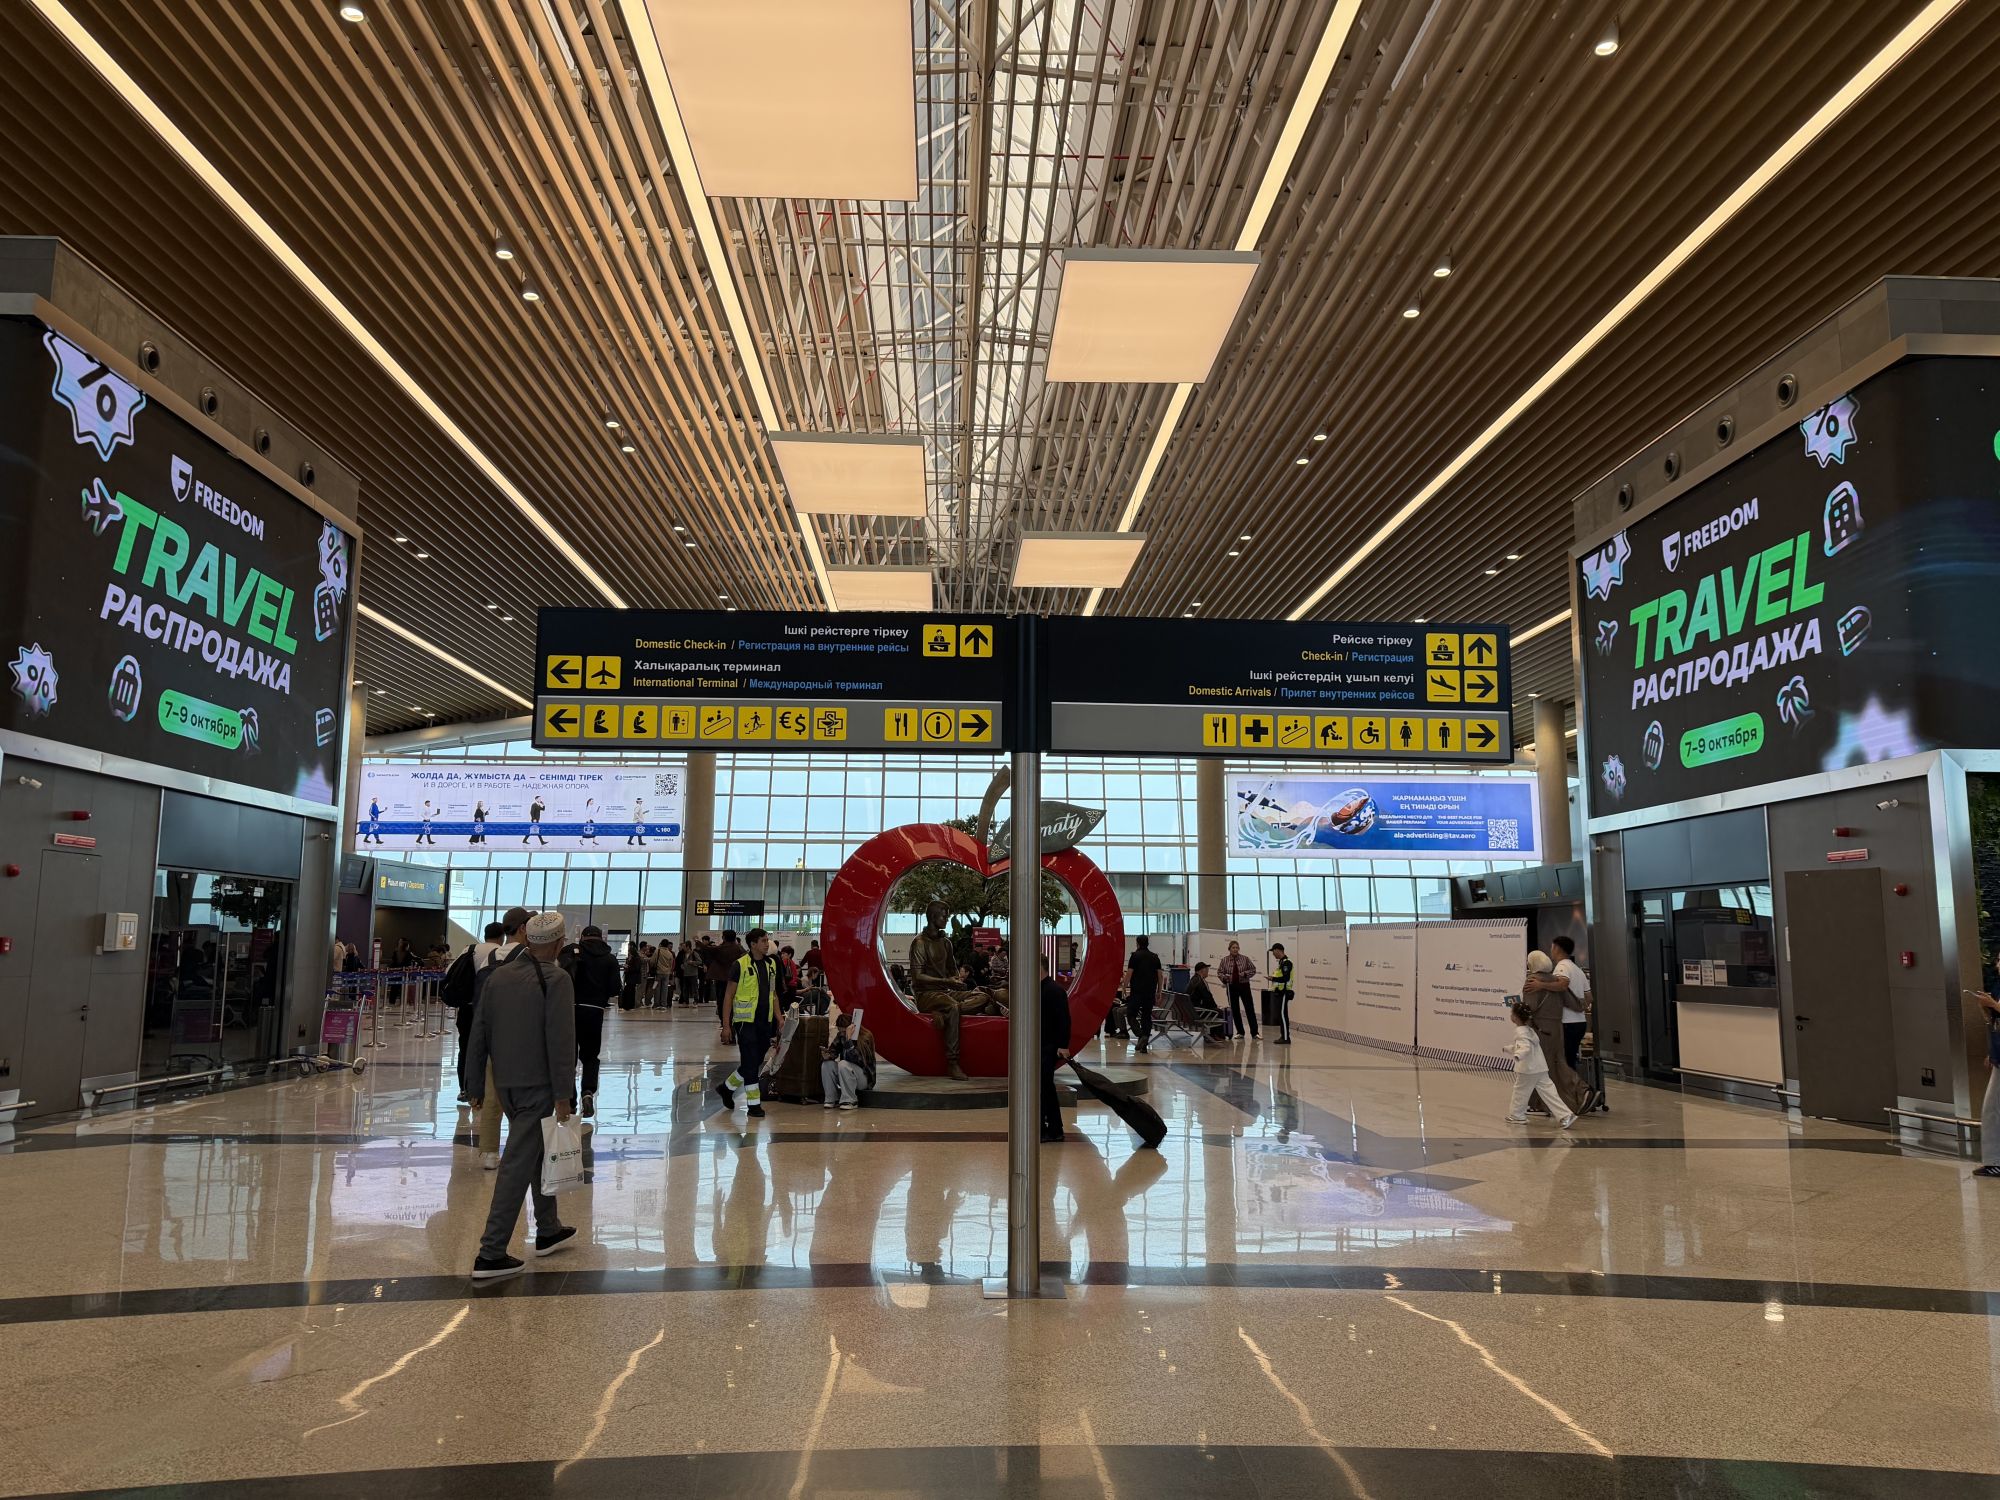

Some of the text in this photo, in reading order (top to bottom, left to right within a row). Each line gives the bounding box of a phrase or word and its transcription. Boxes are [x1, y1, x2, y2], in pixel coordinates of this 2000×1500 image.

[194, 480, 265, 541] FREEDOM
[1684, 497, 1759, 557] FREEDOM
[111, 491, 298, 655] TRAVEL
[1630, 531, 1825, 669] TRAVEL
[100, 583, 292, 695] РАСПРОДАЖА
[784, 625, 909, 639] Ішкі рейстерге тіркеу
[635, 639, 681, 649] Domestic
[684, 639, 727, 650] Check-in
[738, 640, 801, 653] Регистрация
[803, 643, 815, 651] на
[818, 643, 875, 654] внутренние
[877, 643, 909, 654] рейсы
[1333, 634, 1413, 647] Рейске тіркеу
[1301, 651, 1343, 661] Check-in
[1351, 652, 1414, 664] Регистрация
[1632, 617, 1822, 710] РАСПРОДАЖА
[634, 660, 781, 673] Халықаралық терминал
[633, 677, 694, 688] International
[697, 678, 738, 688] Terminal
[749, 678, 833, 691] Международный
[835, 681, 883, 691] терминал
[1250, 671, 1414, 684] Ішкі рейстердің ұшып келуі
[1189, 685, 1233, 696] Domestic
[1235, 686, 1272, 697] Arrivals
[1280, 688, 1317, 700] Прилет
[1319, 690, 1376, 701] внутренних
[1379, 690, 1415, 701] рейсов
[190, 712, 238, 739] октября
[1708, 725, 1758, 754] октября
[411, 772, 444, 780] ЖОЛДА
[446, 773, 462, 781] ДА,
[539, 774, 576, 782] СЕНІМДІ
